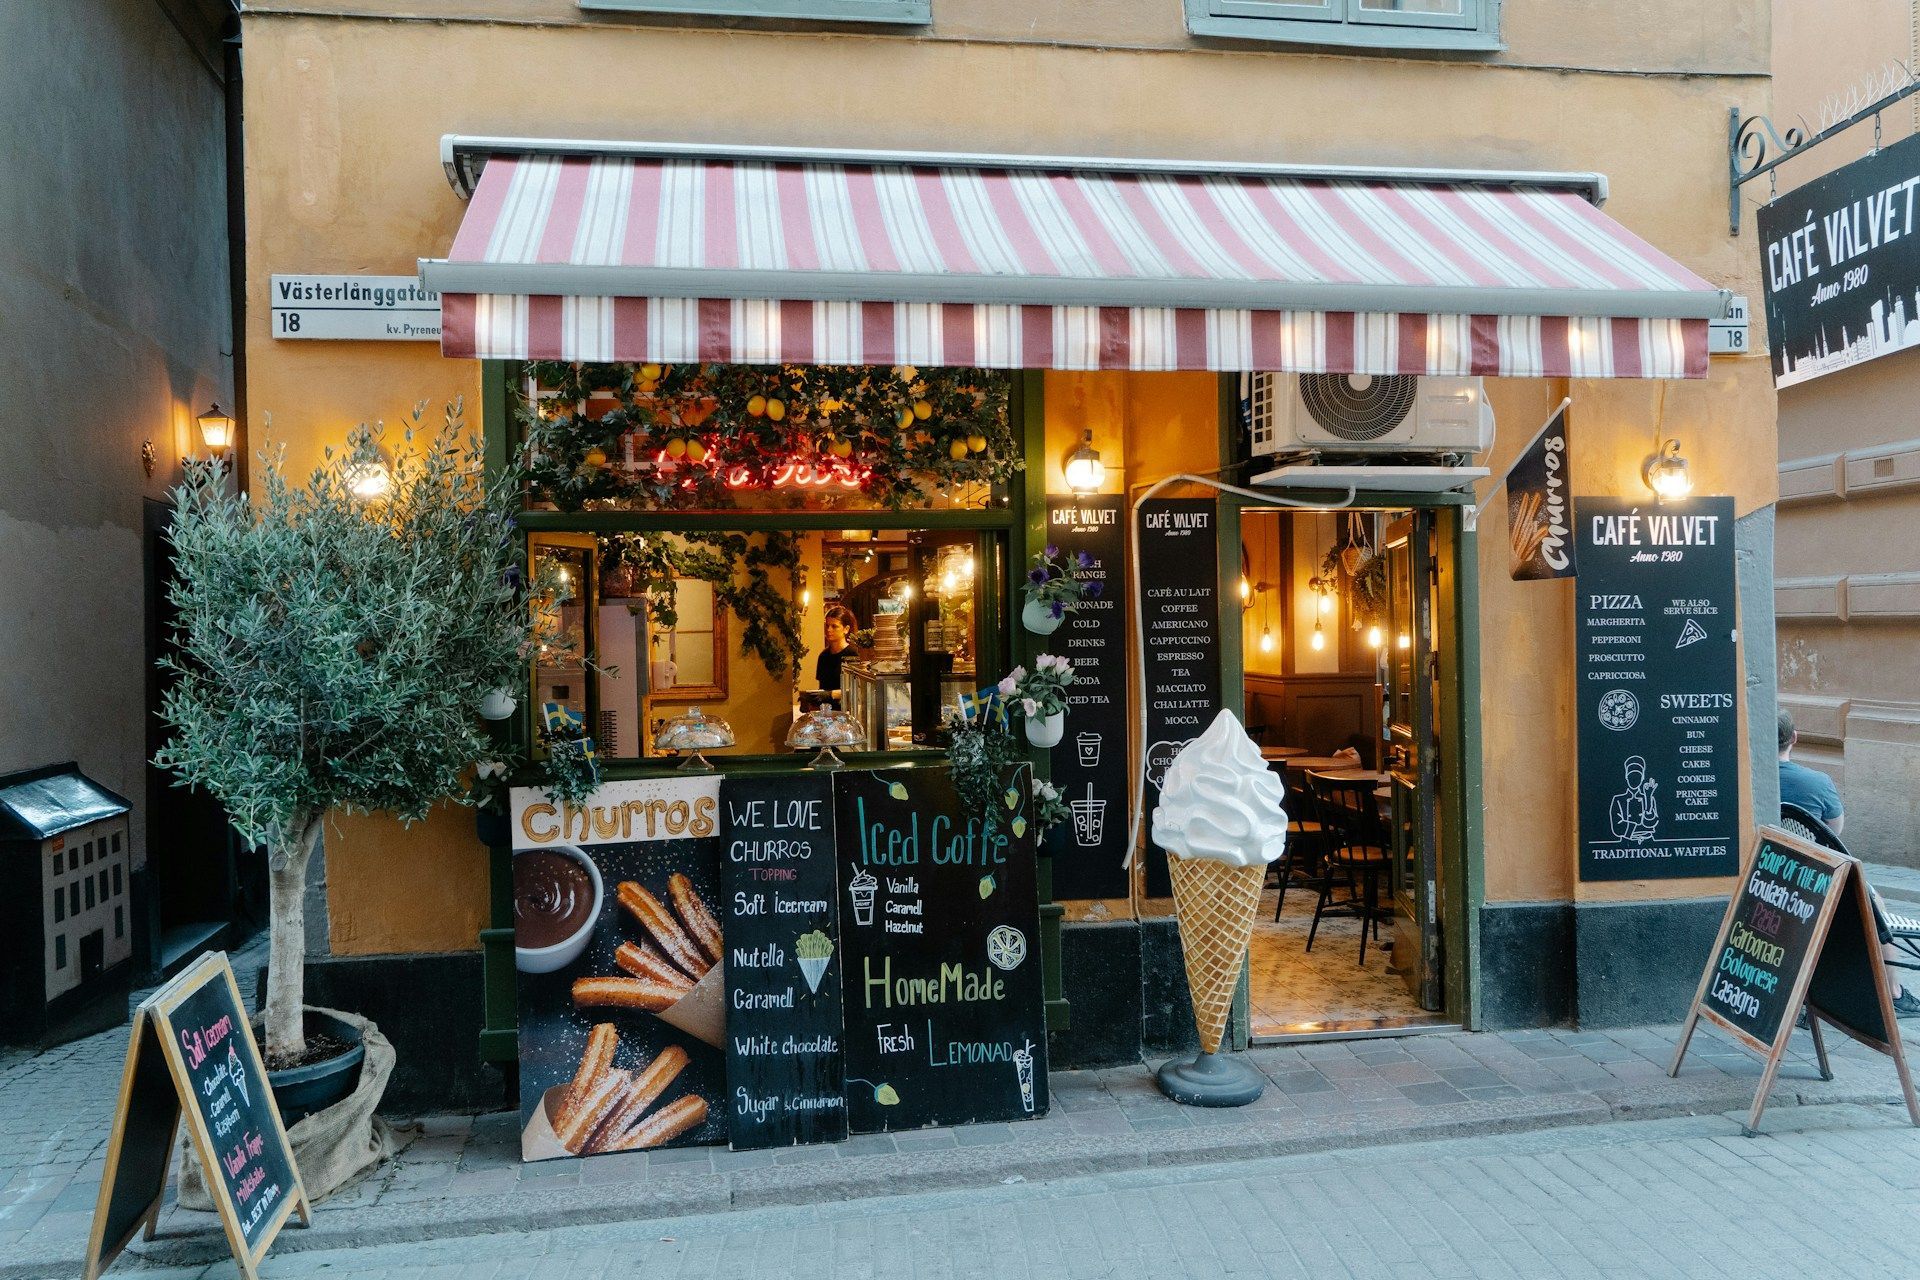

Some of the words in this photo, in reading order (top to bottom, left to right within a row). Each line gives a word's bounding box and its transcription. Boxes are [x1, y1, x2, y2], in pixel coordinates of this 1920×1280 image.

[1767, 207, 1820, 294] CAFÉ
[1823, 175, 1920, 267] VALVET
[1811, 280, 1840, 307] Anno
[1843, 264, 1869, 292] 1980
[279, 282, 438, 306] Västerlånggatan
[280, 312, 301, 333] 18
[386, 323, 401, 334] kv.
[404, 324, 441, 336] Pyreneu
[1727, 330, 1743, 348] 18
[1053, 506, 1077, 524] CAFÉ
[1081, 509, 1117, 524] VALVET
[1146, 510, 1170, 528] CAFÉ
[1173, 513, 1209, 528] VALVET
[1592, 507, 1641, 546] CAFÉ
[1648, 515, 1719, 546] VALVET
[1630, 550, 1659, 563] Anno
[1660, 551, 1683, 562] 1980
[1073, 571, 1107, 579] RANGE
[1147, 587, 1172, 597] CAFÉ
[1173, 588, 1187, 597] AU
[1188, 588, 1211, 597] LAIT
[1071, 601, 1114, 610] MONADE
[1590, 595, 1644, 610] PIZZA
[1688, 599, 1710, 607] ALSO
[1161, 604, 1198, 613] COFFEE
[1664, 607, 1692, 615] SERVE
[1693, 606, 1718, 615] SLICE
[1072, 620, 1101, 629] COLD
[1151, 620, 1209, 630] AMERICANO
[1587, 618, 1646, 626] MARGHERITA
[1068, 638, 1105, 648] DRINKS
[1150, 635, 1211, 646] CAPPUCCINO
[1592, 635, 1642, 644] PEPPERONI
[1074, 657, 1099, 667] BEER
[1157, 652, 1204, 661] ESPRESSO
[1588, 654, 1645, 662] PROSCIUTTO
[1171, 668, 1190, 677] TEA
[1587, 672, 1646, 680] CAPRICCIOSA
[1073, 676, 1101, 685] SODA
[1156, 683, 1206, 694] MACCIATO
[1065, 695, 1089, 704] ICED
[1090, 695, 1110, 704] TEA
[1153, 700, 1180, 709] CHAI
[1180, 700, 1210, 709] LATTE
[1660, 693, 1733, 709] SWEETS
[1165, 716, 1199, 725] MOCCA
[1672, 716, 1719, 724] CINNAMON
[1686, 731, 1705, 739] BUN
[1679, 745, 1713, 754] CHEESE
[1682, 760, 1711, 769] CAKES
[1677, 775, 1716, 783] COOKIES
[1676, 789, 1717, 798] PRINCESS
[1685, 798, 1709, 806] CAKE
[729, 800, 765, 828] WE
[774, 800, 823, 831] LOVE
[1675, 812, 1719, 821] MUDCAKE
[857, 796, 919, 866] Iced
[730, 839, 812, 862] CHURROS
[1592, 848, 1672, 860] TRADITIONAL
[1674, 846, 1727, 857] WAFFLES
[748, 867, 798, 881] TOPPING
[1782, 858, 1800, 882] OF
[886, 876, 919, 894] Vanilla
[734, 891, 767, 916] Soft
[885, 920, 924, 934] Hazelnut
[1729, 920, 1785, 968] Carbonara
[733, 943, 785, 968] Nutella
[1720, 947, 1779, 994] Bolognese
[733, 986, 795, 1010] Caramell
[1711, 971, 1760, 1019] Lasagna
[734, 1034, 778, 1057] White
[736, 1085, 779, 1123] Sugar
